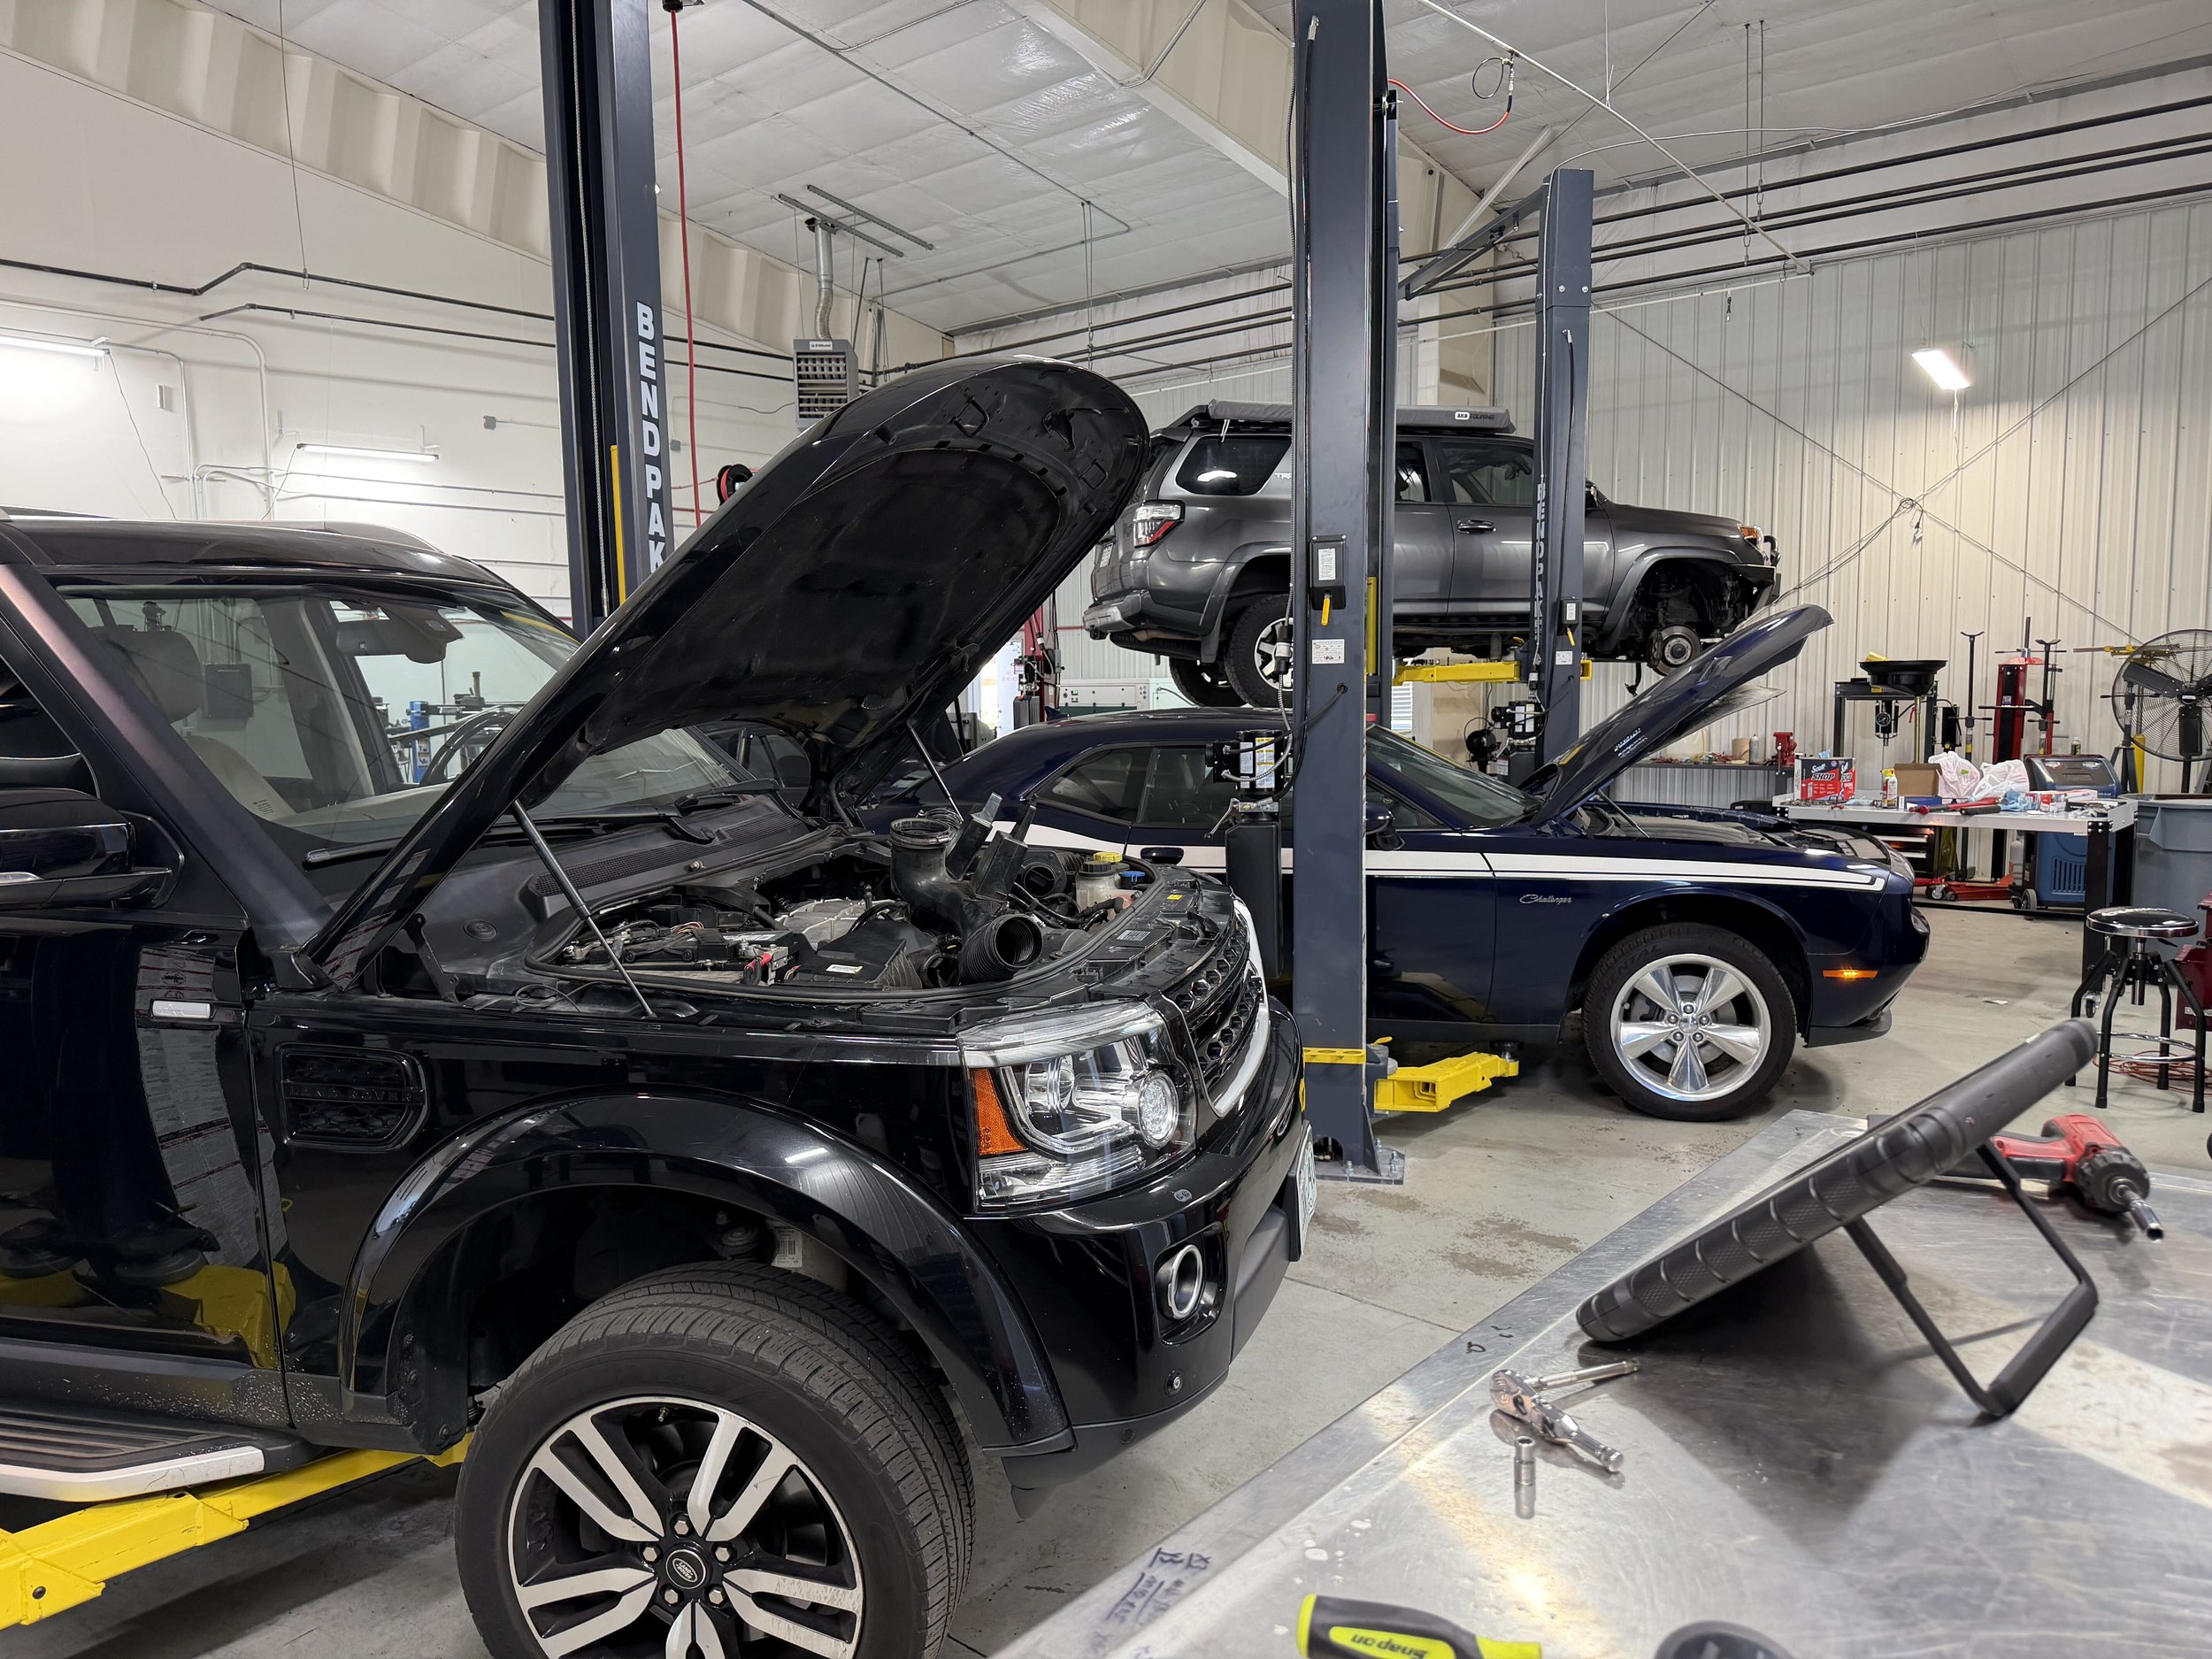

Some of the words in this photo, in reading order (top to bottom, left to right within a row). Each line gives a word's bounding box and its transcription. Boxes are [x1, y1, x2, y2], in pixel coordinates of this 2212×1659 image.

[636, 301, 666, 573] BENDPAK
[1519, 894, 1572, 905] Challenger
[288, 1086, 340, 1098] LAND
[348, 1089, 413, 1102] ROVER
